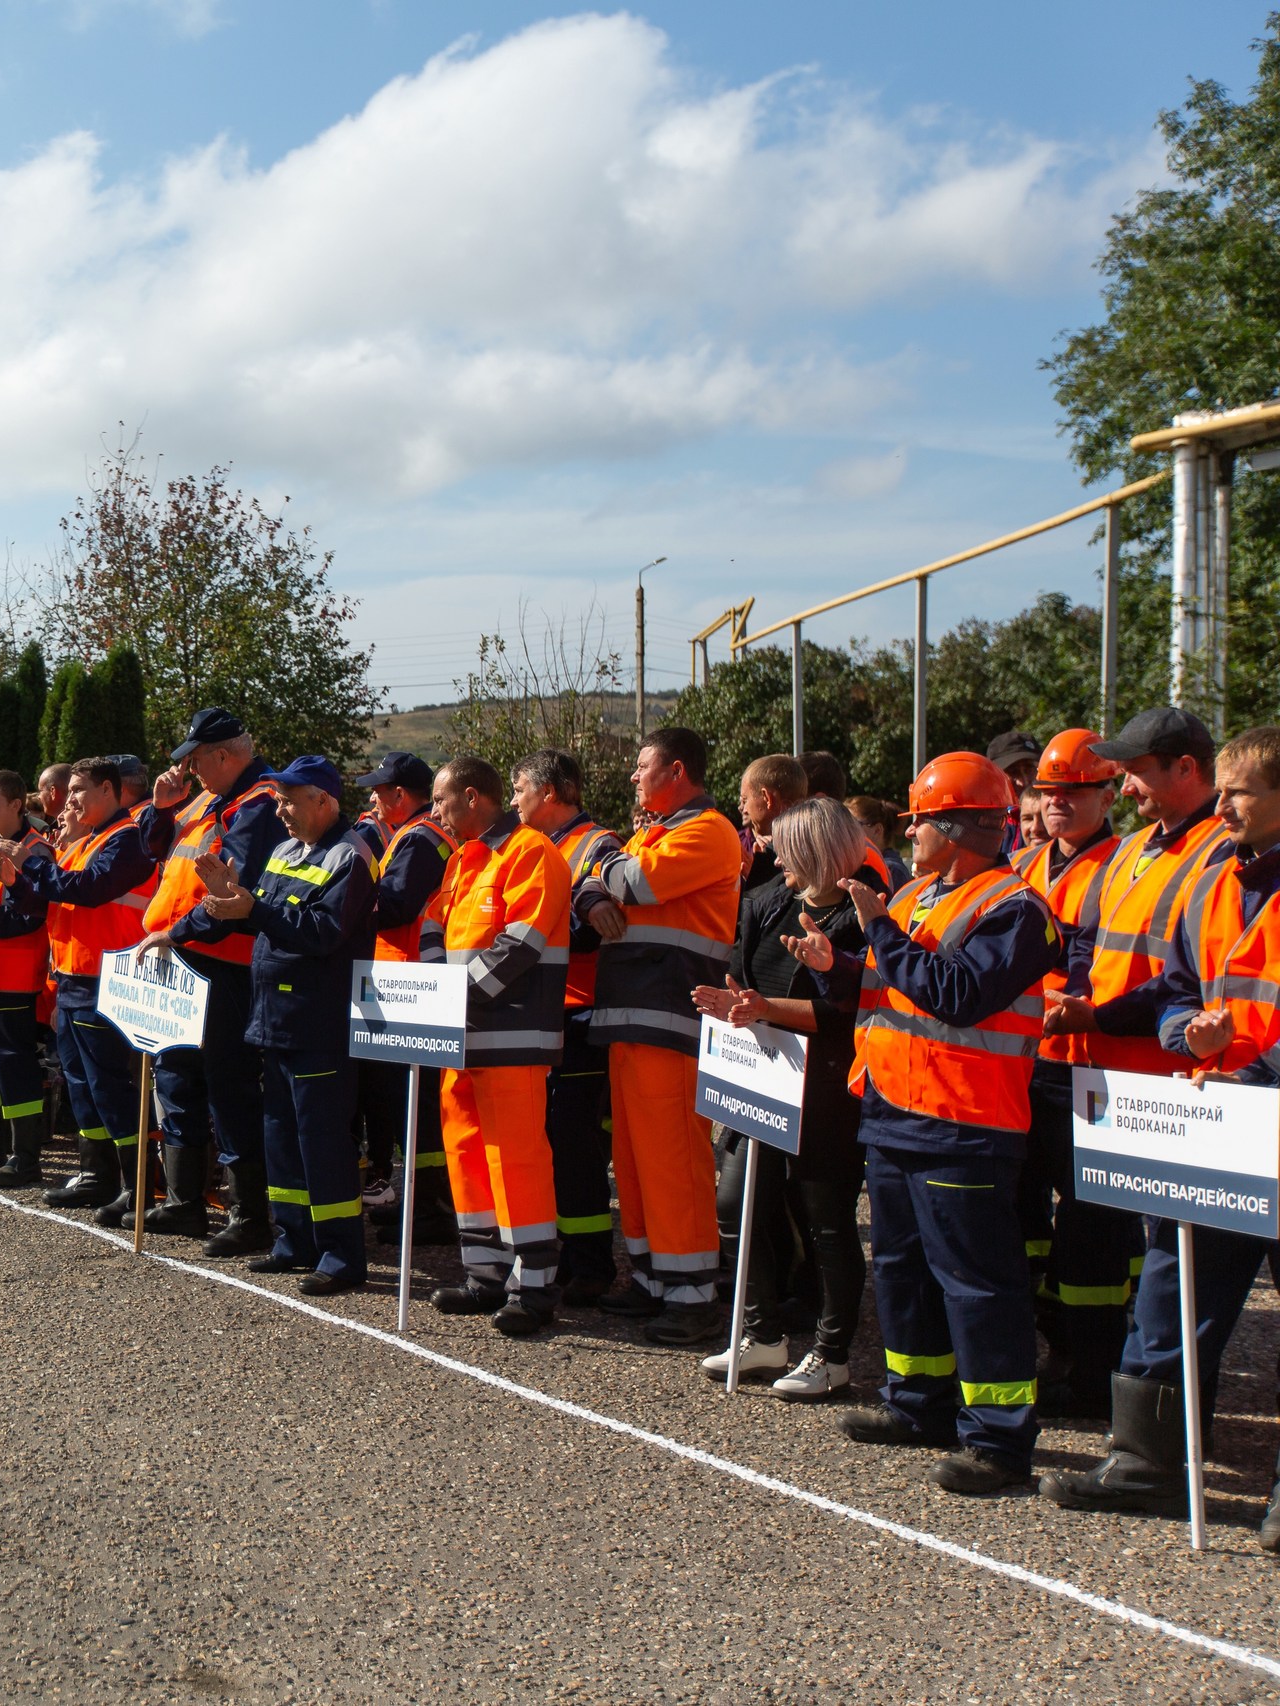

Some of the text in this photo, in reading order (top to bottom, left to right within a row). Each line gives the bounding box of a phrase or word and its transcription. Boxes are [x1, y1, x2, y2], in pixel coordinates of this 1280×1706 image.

[114, 954, 130, 976] ПТП
[180, 969, 195, 995] ОСВ
[378, 978, 438, 992] СТАВРОПОЛЬКРАЙ
[108, 977, 139, 1004] ФИЛИАЛА
[142, 986, 156, 1008] ГУП
[160, 991, 169, 1012] СК
[378, 992, 417, 1004] ВОДОКАНАЛ
[354, 1031, 460, 1053] ПТП МИНЕРАЛОВОДСКОЕ
[722, 1033, 777, 1059] СТАВРОПОЛЬКРАЙ
[721, 1048, 757, 1069] ВОДОКАНАЛ
[705, 1087, 788, 1132] ПТП АНДРОПОВСКОЕ
[1116, 1096, 1223, 1122] СТАВРОПОЛЬКРАЙ
[1116, 1115, 1186, 1136] ВОДОКАНАЛ
[1082, 1166, 1269, 1215] ПТП КРАСНОГВАРДЕЙСКОЕ
